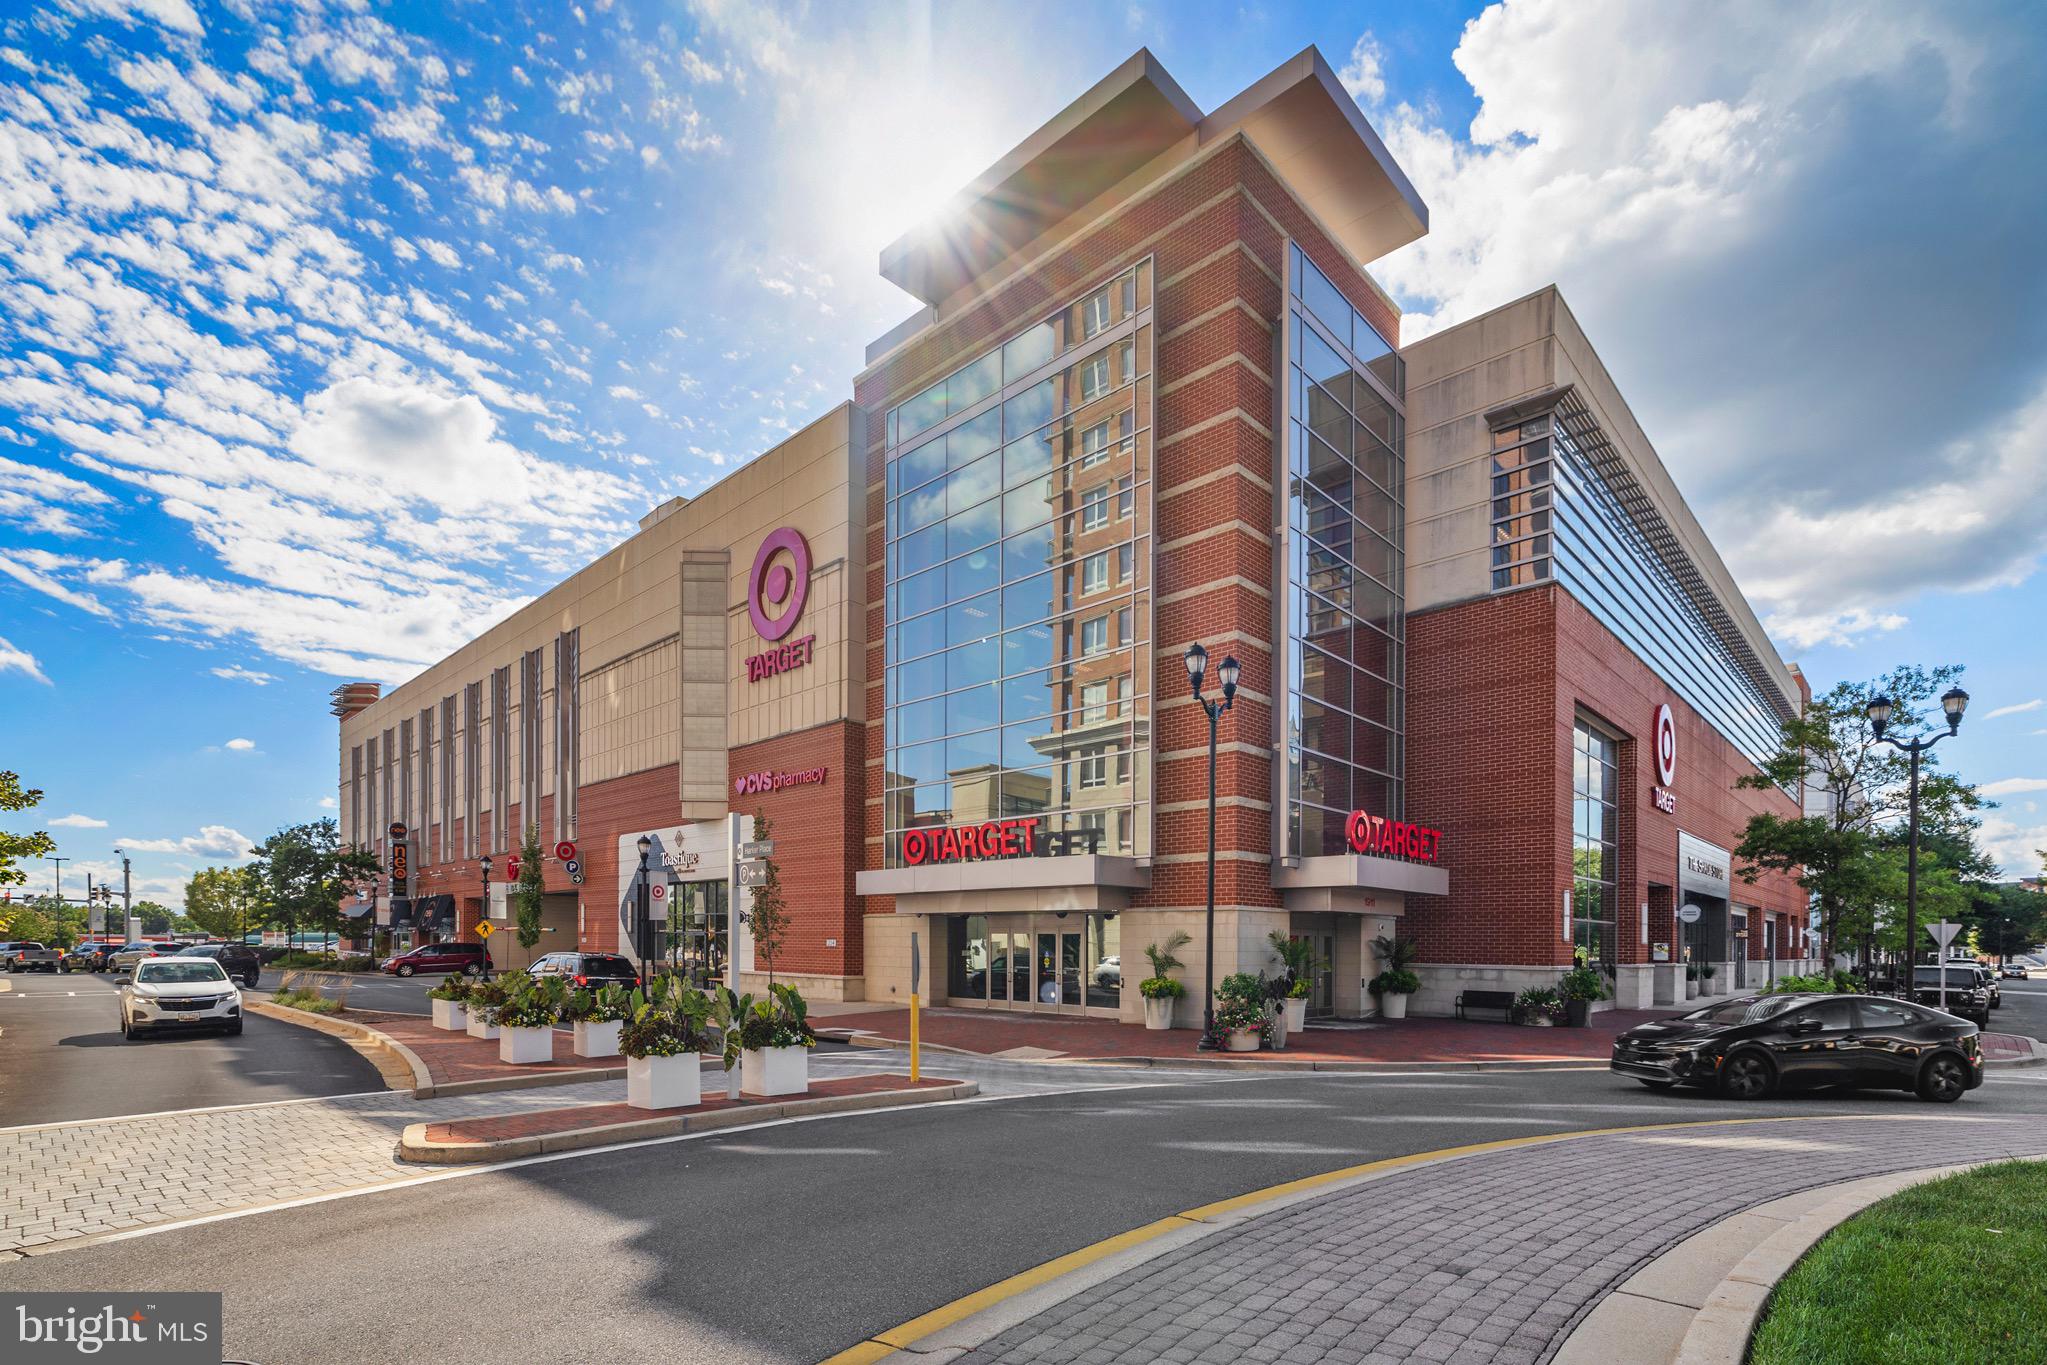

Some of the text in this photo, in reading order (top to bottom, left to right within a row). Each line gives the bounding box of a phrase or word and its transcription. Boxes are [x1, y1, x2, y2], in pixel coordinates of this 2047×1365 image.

[745, 634, 816, 683] TARGET
[746, 766, 826, 794] CVS pharmacy
[1655, 786, 1676, 814] TARGET
[927, 818, 1041, 862] TARGET
[1370, 815, 1442, 862] TARGET
[394, 846, 407, 879] neo
[569, 862, 577, 871] P
[660, 851, 699, 868] Toastique
